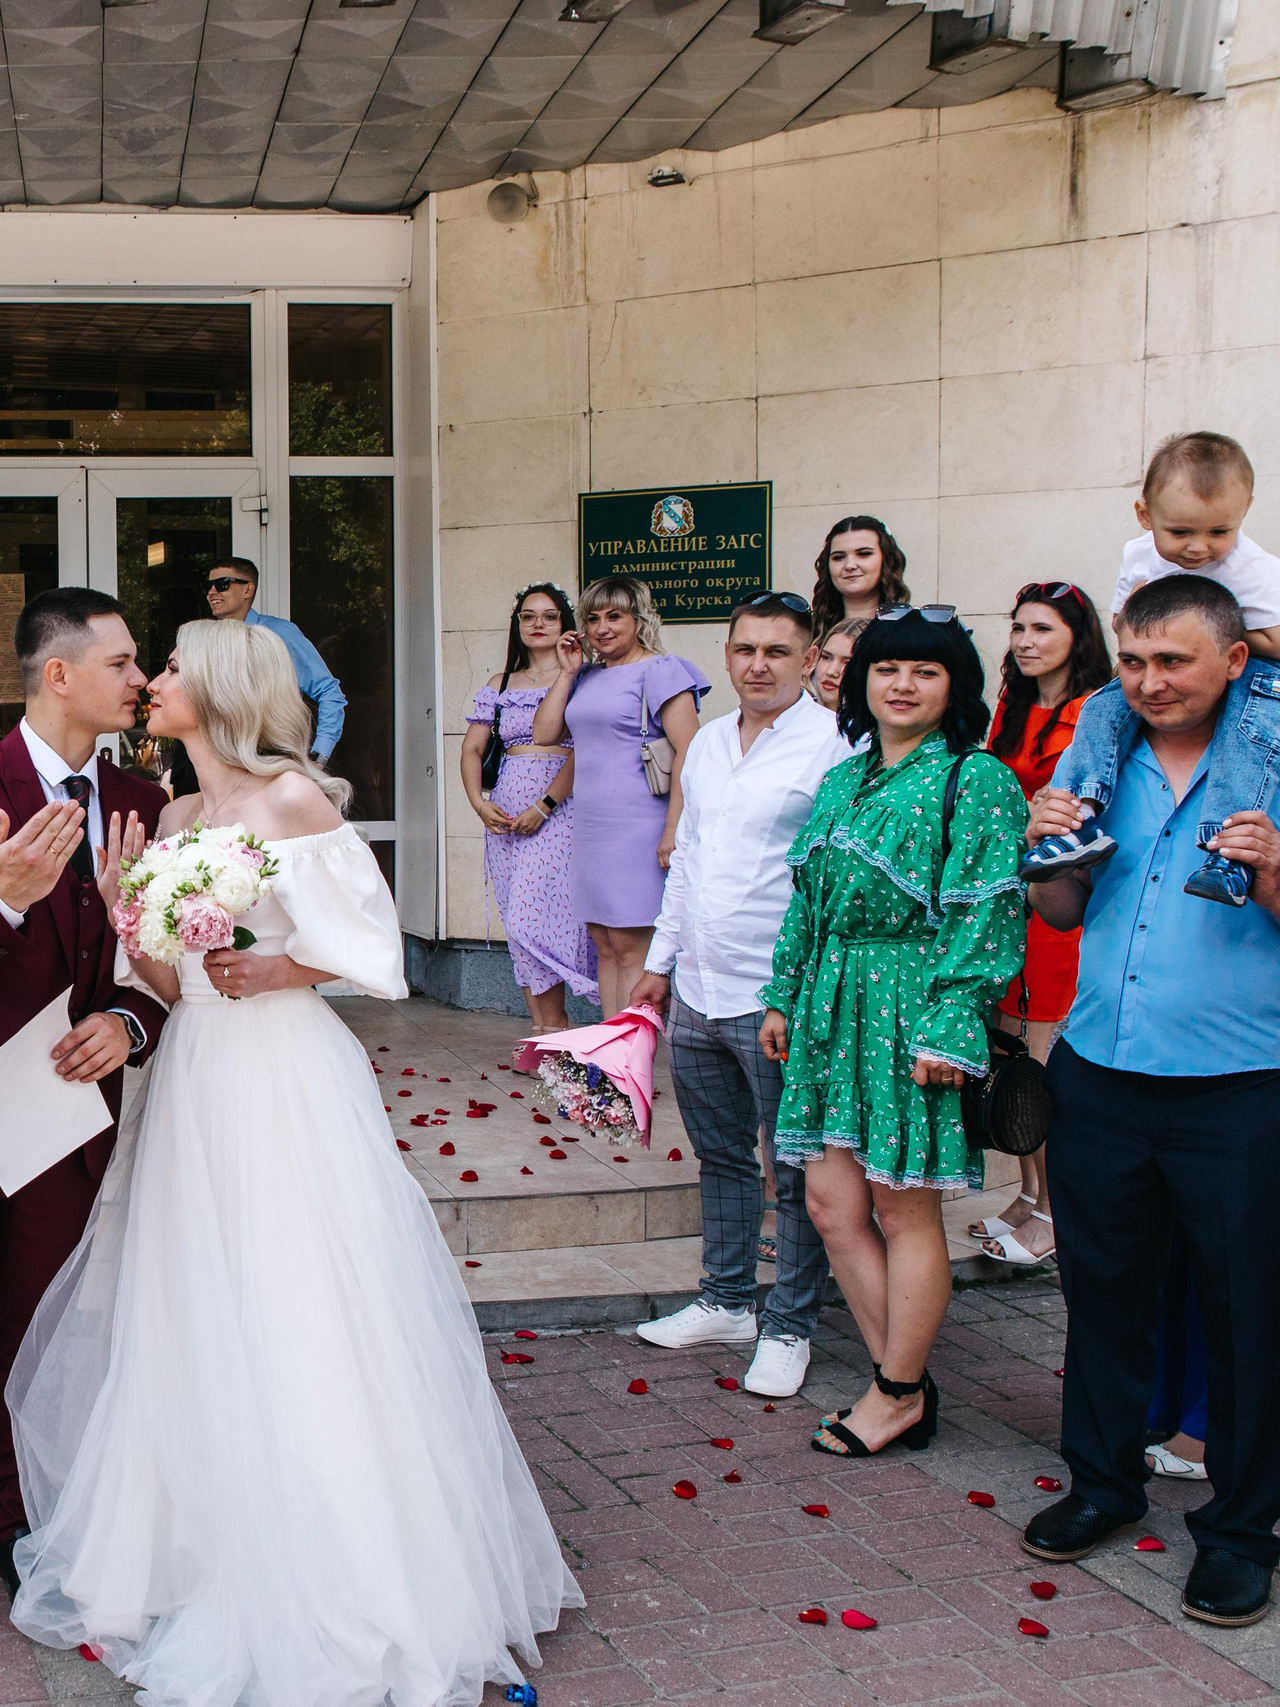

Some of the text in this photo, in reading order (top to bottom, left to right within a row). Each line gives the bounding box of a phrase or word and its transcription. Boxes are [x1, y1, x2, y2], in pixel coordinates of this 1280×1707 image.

[588, 532, 763, 556] УПРАВЛЕНИЕ ЗАГС
[612, 558, 736, 574] администрации
[705, 575, 762, 591] округа
[674, 593, 732, 610] Курска
